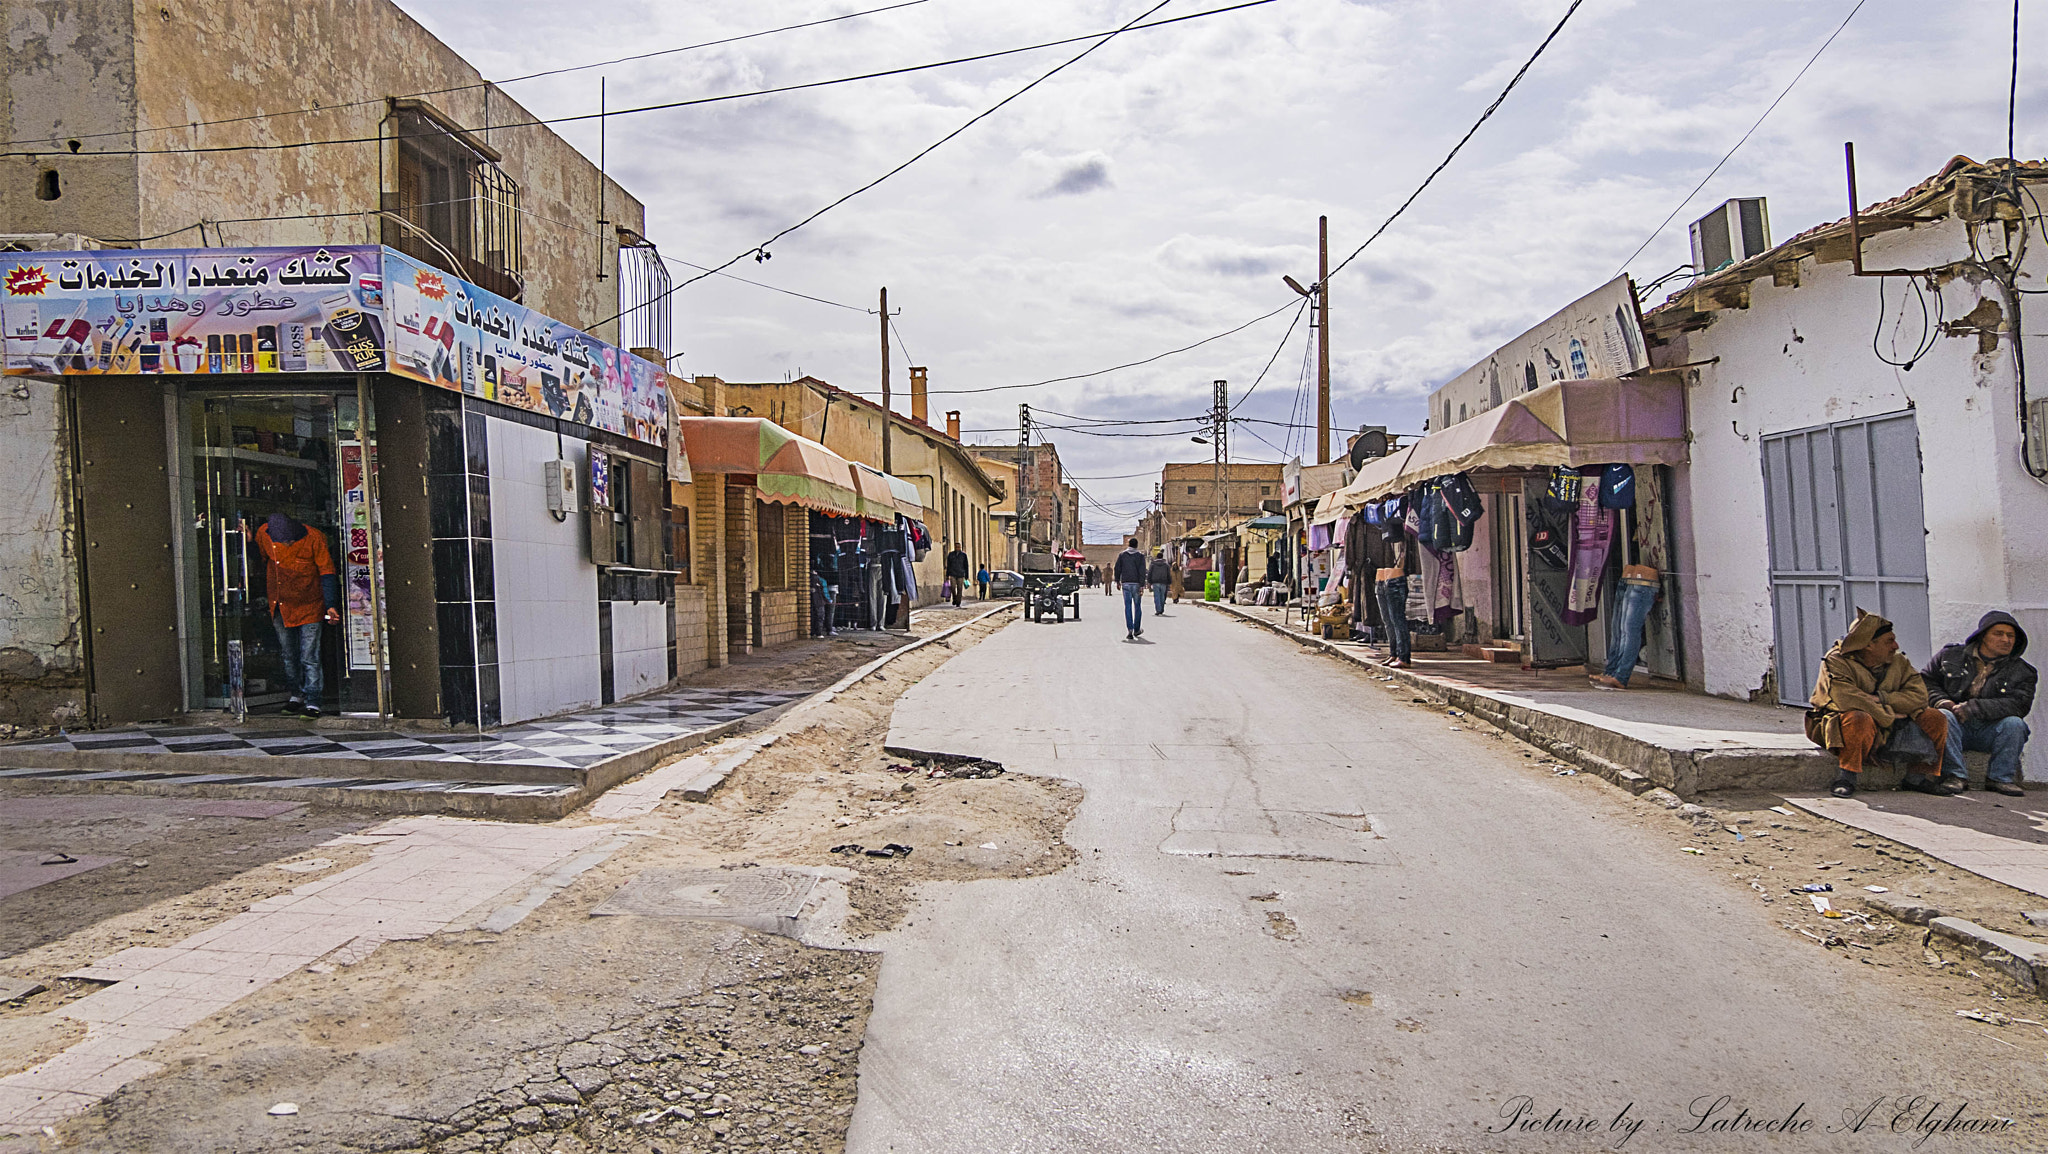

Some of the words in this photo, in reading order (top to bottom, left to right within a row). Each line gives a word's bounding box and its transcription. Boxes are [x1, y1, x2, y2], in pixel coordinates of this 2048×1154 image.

[58, 259, 175, 290] الخدمات
[188, 256, 269, 288] متعدد
[279, 249, 353, 287] كشك
[115, 293, 207, 319] وهدايا
[217, 291, 297, 316] عطور
[454, 291, 517, 341] الخدمات
[291, 325, 302, 357] BOSS
[347, 340, 374, 355] GLISS
[353, 350, 376, 362] KUR
[495, 343, 527, 365] وهدايا
[522, 327, 559, 357] متعدد
[562, 335, 590, 369] كشك
[529, 357, 554, 371] عطور
